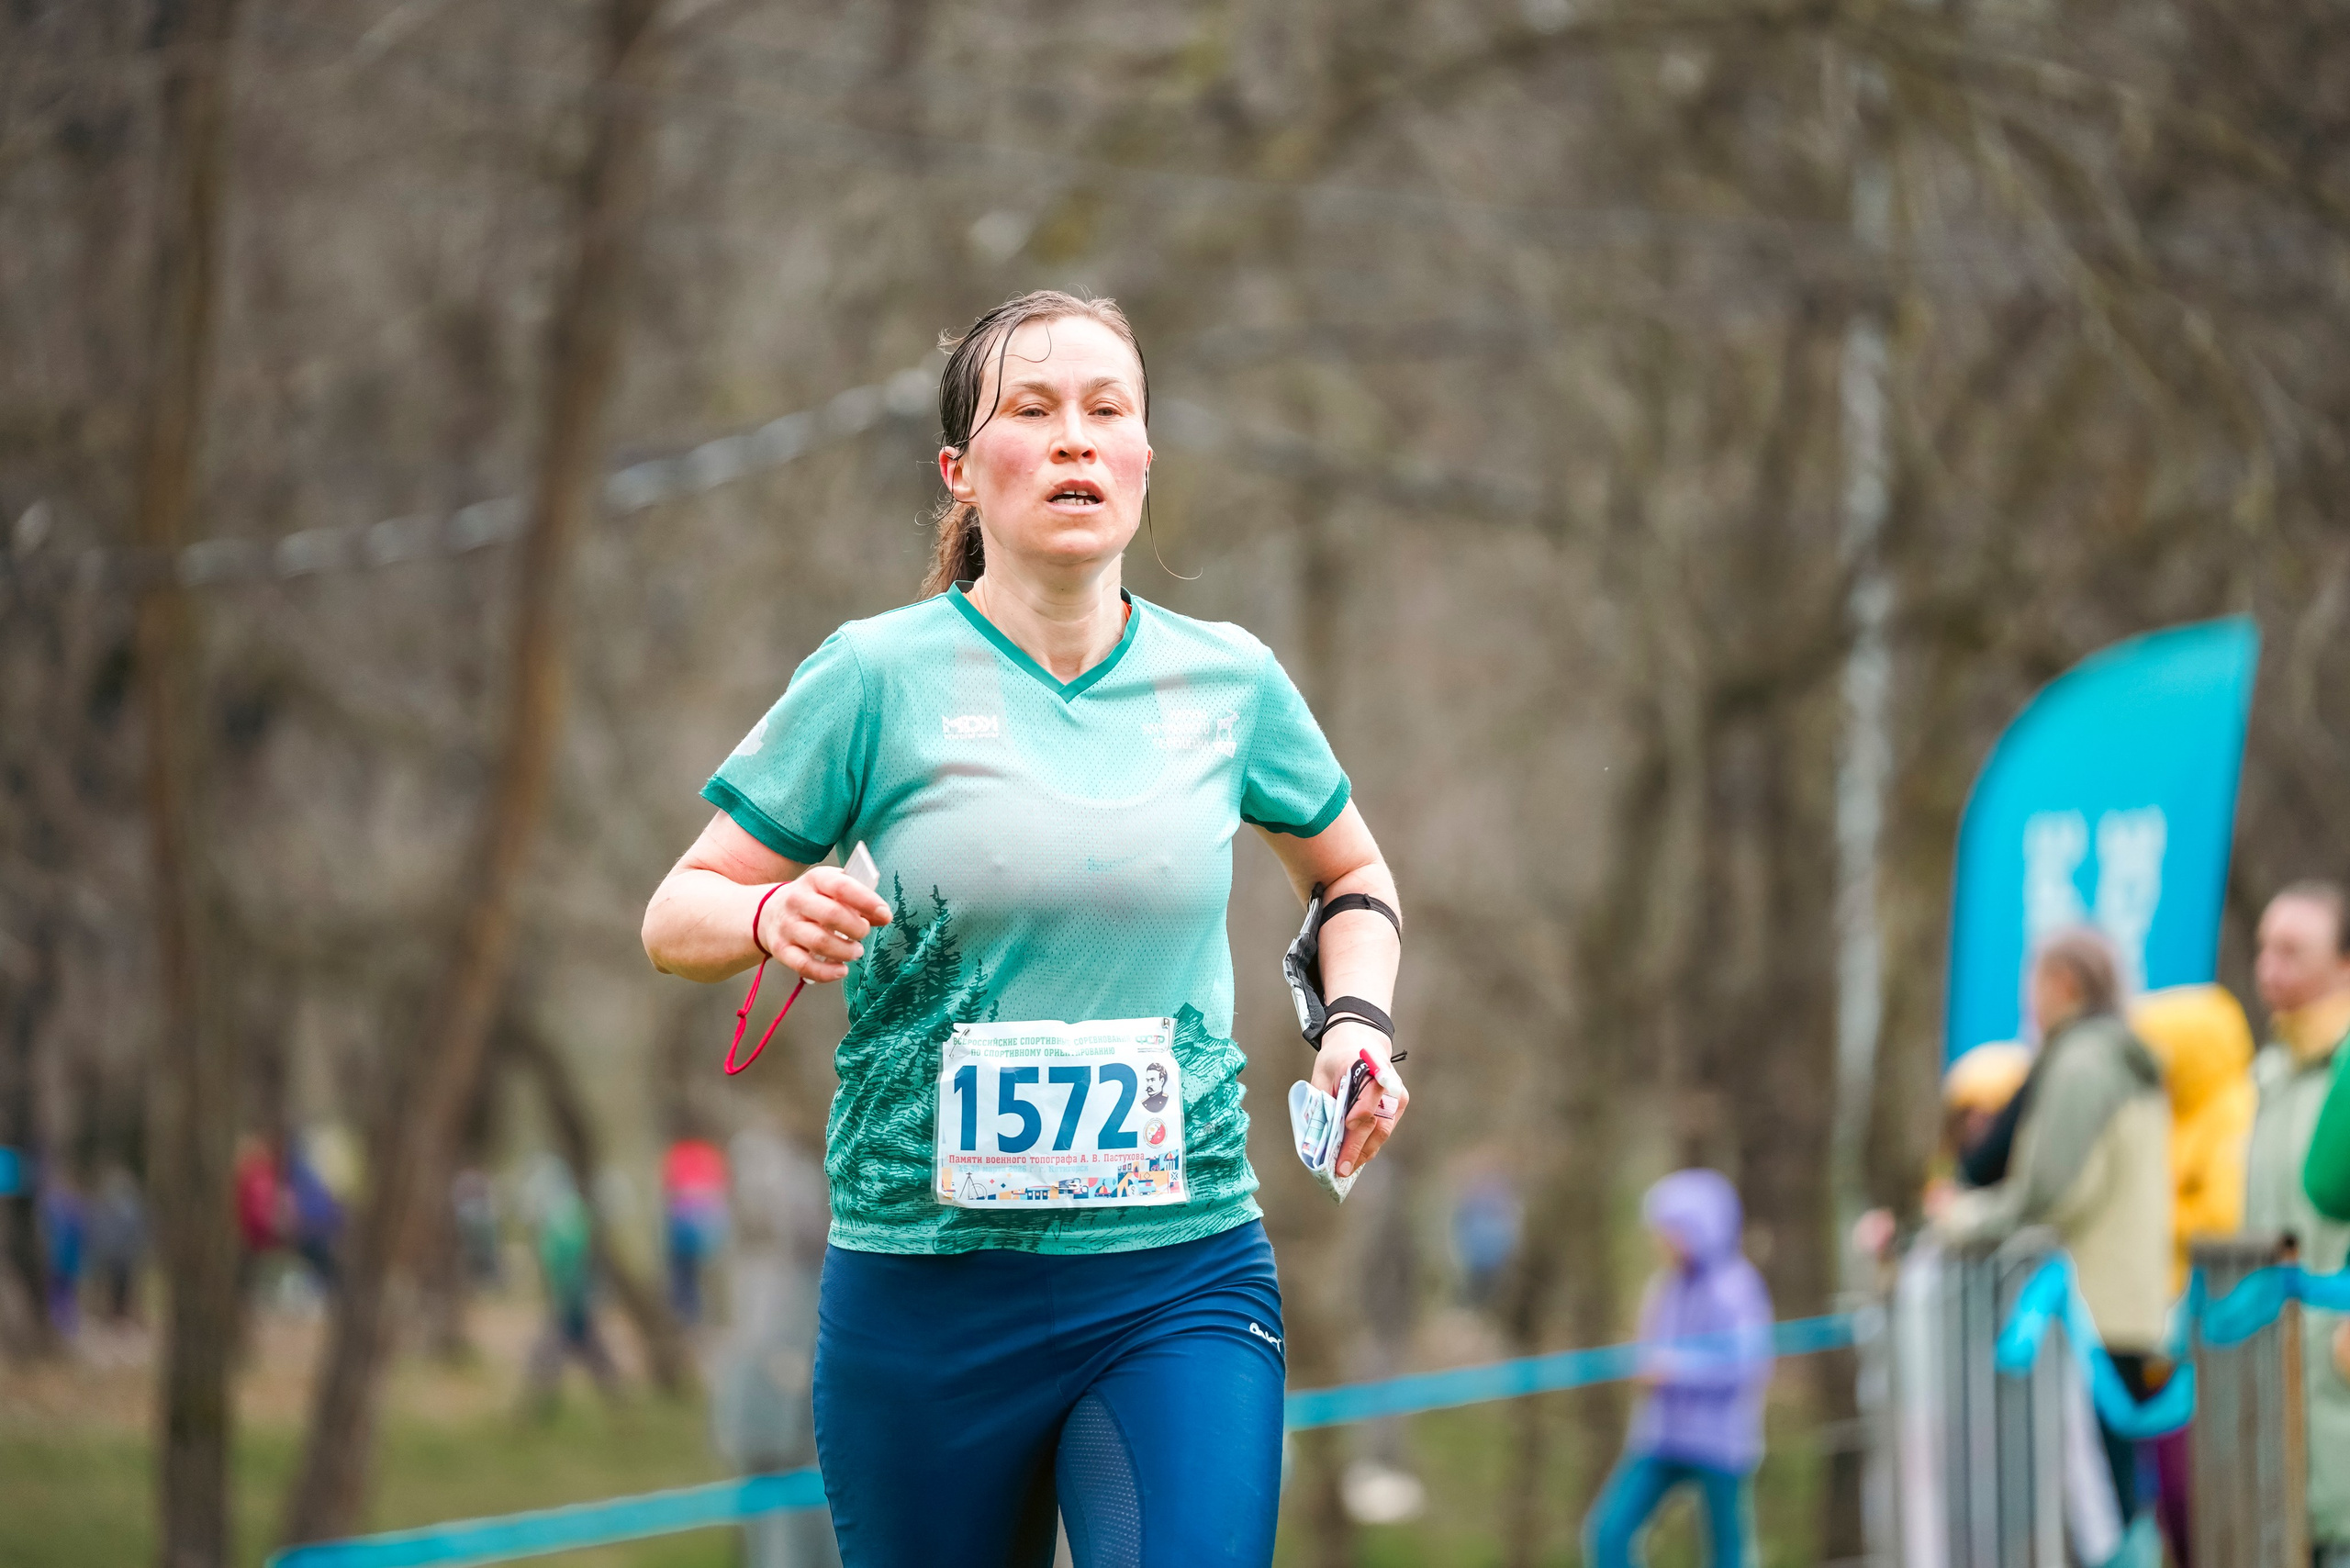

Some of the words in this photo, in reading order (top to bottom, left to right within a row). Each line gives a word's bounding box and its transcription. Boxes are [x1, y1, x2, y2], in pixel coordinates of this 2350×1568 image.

[983, 1048, 1042, 1058] СПОРТИВНОМУ
[953, 1062, 1138, 1153] 1572
[948, 1154, 983, 1164] Памяти
[985, 1156, 1026, 1164] военного
[1029, 1154, 1078, 1166] топографа
[1080, 1154, 1089, 1163] А.
[1091, 1153, 1101, 1162] В.
[1103, 1152, 1145, 1163] Пастухова
